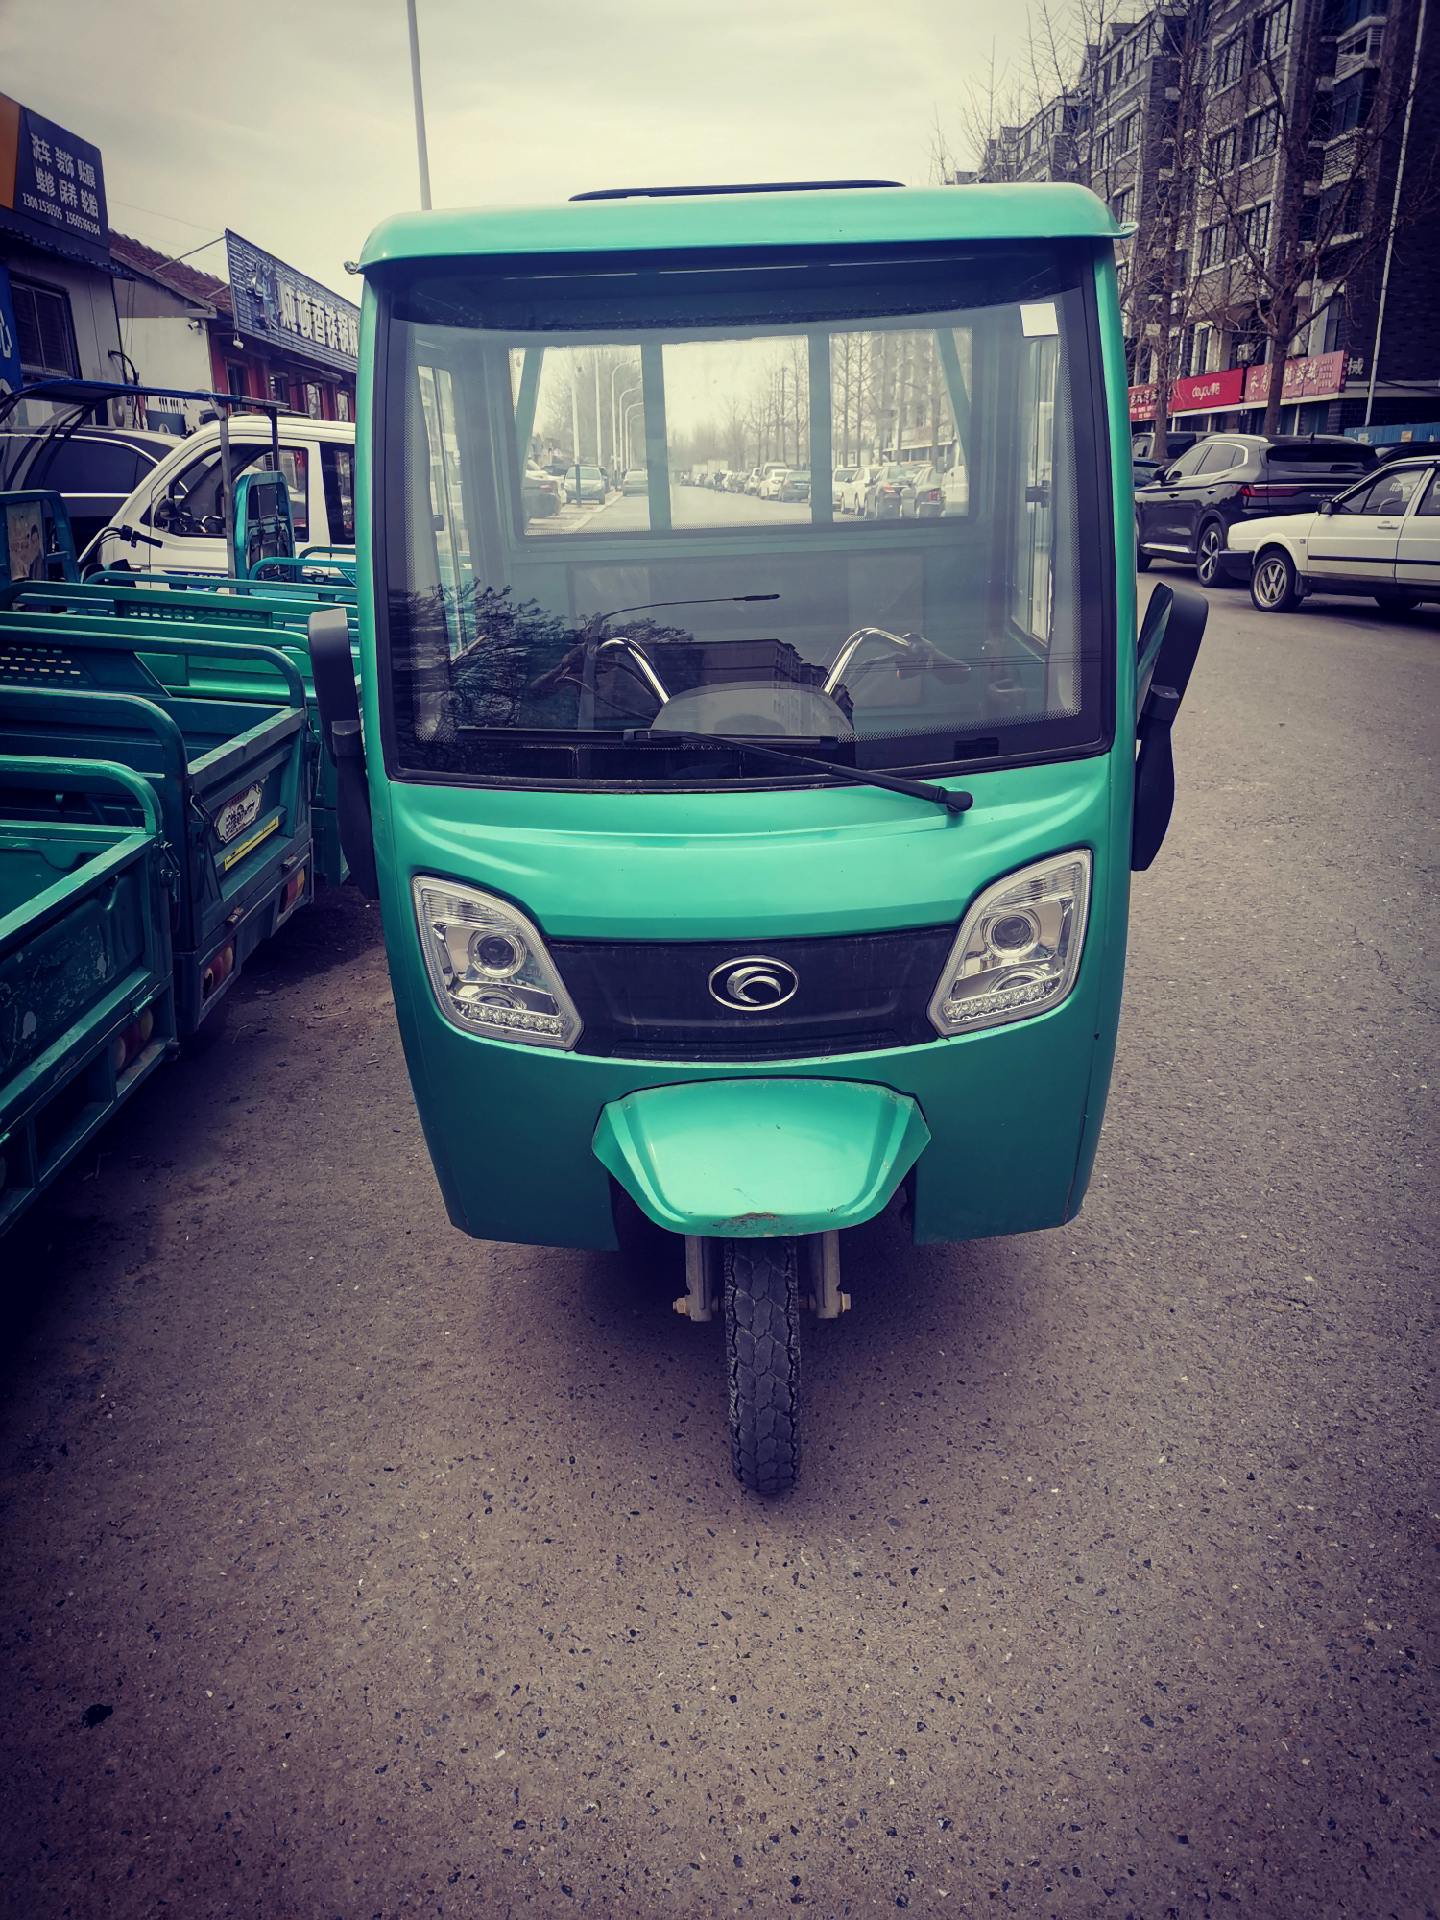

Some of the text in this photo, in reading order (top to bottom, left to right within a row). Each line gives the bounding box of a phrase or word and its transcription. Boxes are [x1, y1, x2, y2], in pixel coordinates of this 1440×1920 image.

[31, 132, 96, 189] 洗车 装饰 贴膜
[35, 165, 99, 218] 维修 保养 轮胎
